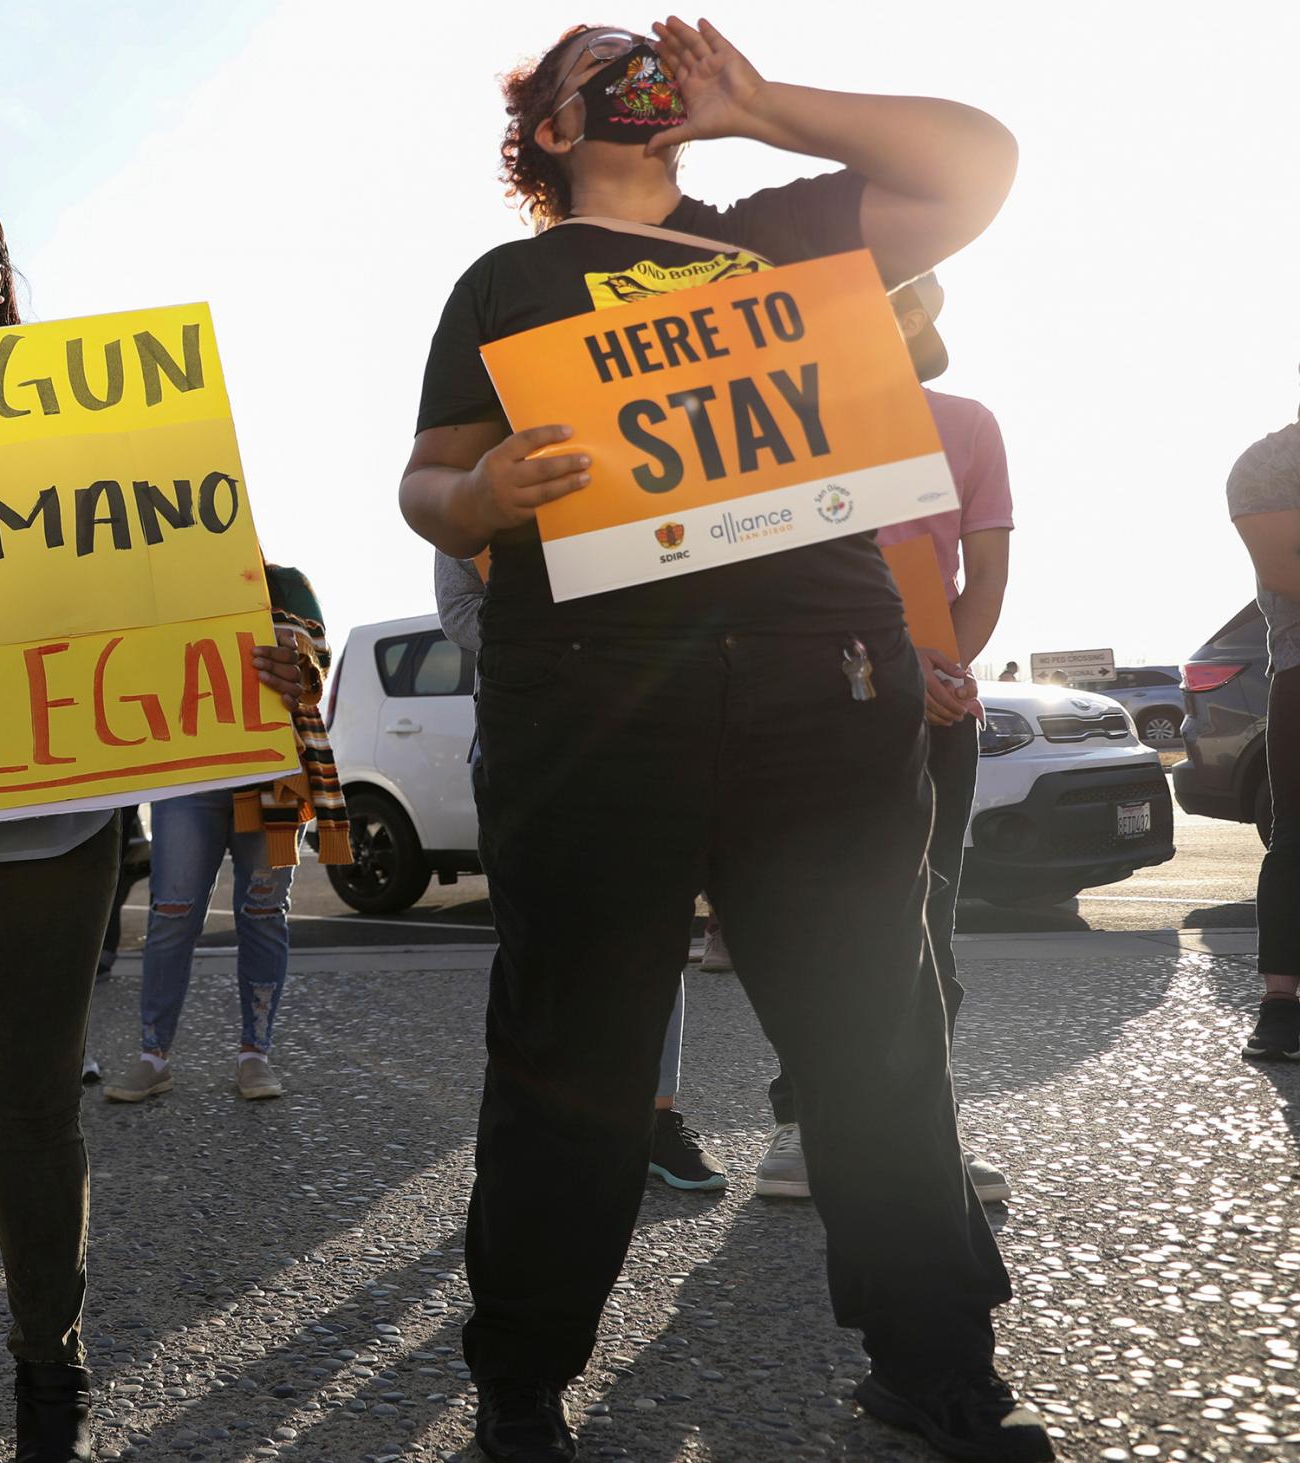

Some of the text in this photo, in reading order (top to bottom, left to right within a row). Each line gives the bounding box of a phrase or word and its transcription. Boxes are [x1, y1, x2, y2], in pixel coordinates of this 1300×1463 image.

[584, 290, 805, 383] HERE TO
[618, 362, 831, 495] STAY
[659, 550, 690, 564] SDIRC
[710, 511, 793, 545] alliance
